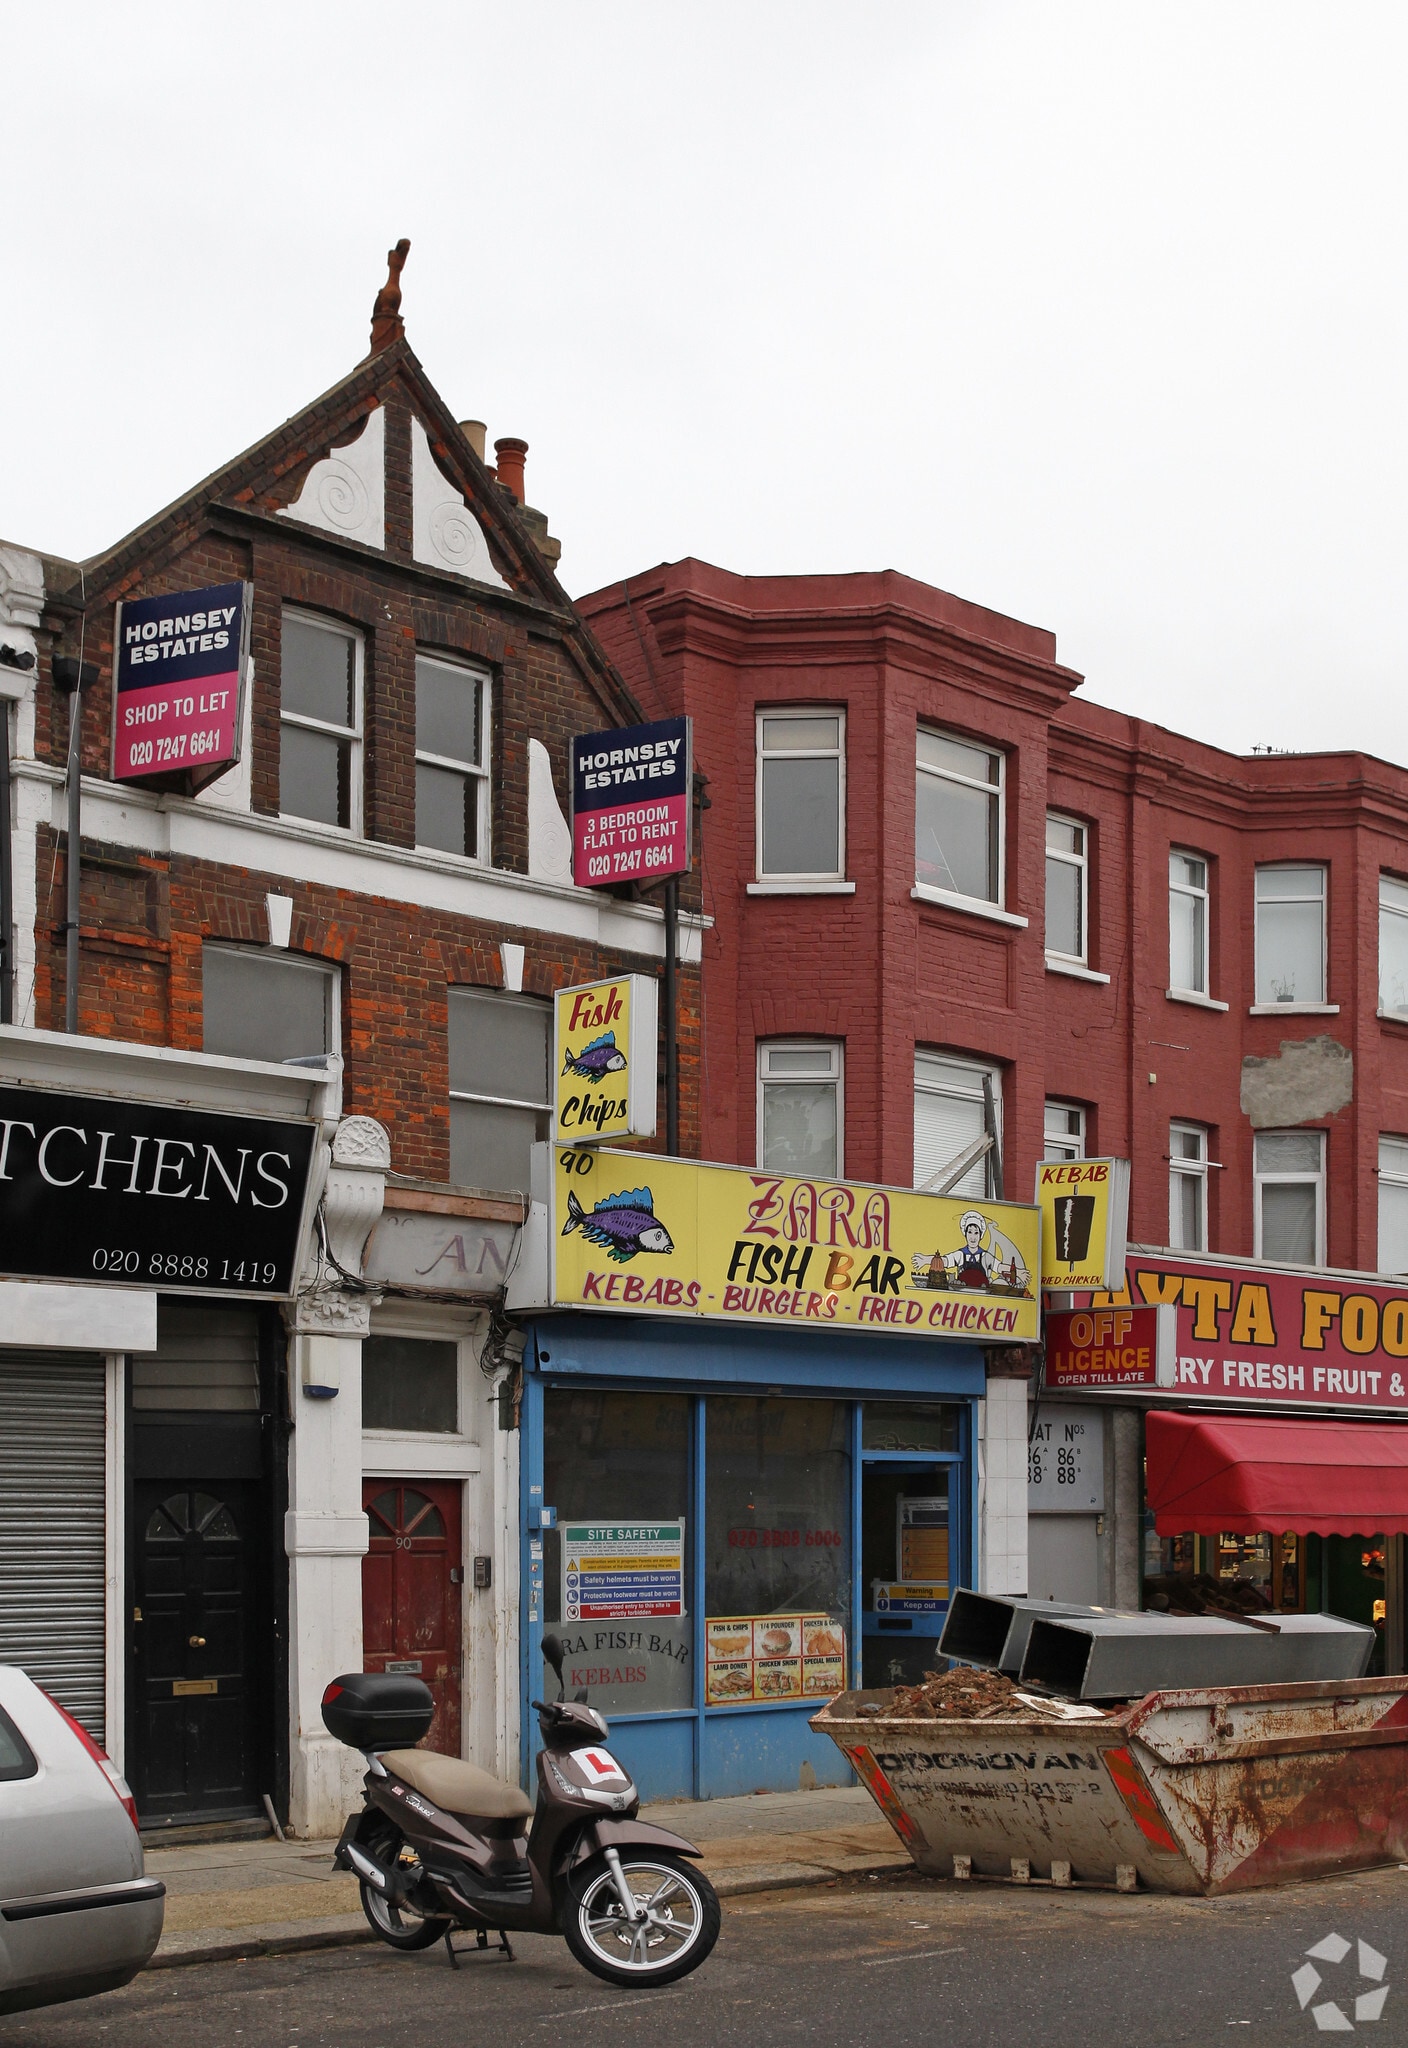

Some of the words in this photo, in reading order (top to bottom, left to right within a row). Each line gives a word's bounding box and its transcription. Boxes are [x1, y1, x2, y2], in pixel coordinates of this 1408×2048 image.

[126, 606, 237, 644] HORNSEY
[130, 630, 230, 665] ESTATES
[124, 701, 169, 727] SHOP
[173, 697, 194, 718] TO
[200, 690, 229, 713] LET
[129, 740, 153, 766] 020
[157, 734, 187, 762] 7247
[190, 728, 221, 756] 6641
[579, 738, 682, 772] HORNSEY
[584, 759, 676, 790] ESTATES
[587, 818, 596, 833] 3
[600, 805, 669, 831] BEDROOM
[583, 832, 616, 850] FLAT
[619, 828, 637, 844] TO
[642, 821, 678, 838] RENT
[589, 854, 610, 877] 020
[613, 849, 642, 873] 7247
[645, 844, 673, 868] 6641
[568, 986, 623, 1032] Fish
[560, 1093, 628, 1132] Chips
[0, 1119, 291, 1208] TCHENS
[559, 1150, 594, 1176] 90
[1041, 1165, 1109, 1185] KEBAB
[743, 1175, 892, 1252] ZARA
[92, 1248, 140, 1273] 020
[149, 1253, 209, 1279] 8888
[219, 1259, 276, 1284] 1419
[727, 1240, 813, 1289] FISH
[824, 1250, 905, 1296] BAR
[1041, 1275, 1061, 1285] RIED
[1063, 1275, 1102, 1285] CHICKEN
[582, 1271, 702, 1308] KEBABS
[722, 1284, 839, 1319] BURGERS
[858, 1296, 923, 1325] FRIED
[928, 1302, 1019, 1333] CHICKEN
[1069, 1310, 1133, 1348] OFF
[1055, 1347, 1150, 1372] LICENCE
[1057, 1374, 1087, 1385] OPEN
[1090, 1373, 1114, 1384] TILL
[1117, 1372, 1145, 1383] LATE
[1175, 1357, 1214, 1385] RY
[1222, 1360, 1305, 1392] FRESH
[1313, 1367, 1382, 1396] FRUIT
[1389, 1372, 1405, 1397] &
[395, 1536, 412, 1550] 90
[588, 1529, 614, 1540] SITE
[617, 1529, 660, 1540] SAFETY
[728, 1528, 758, 1547] 020
[805, 1529, 841, 1547] 6006
[584, 1576, 605, 1584] Safety
[606, 1575, 632, 1583] helmets
[905, 1586, 934, 1596] Warning
[903, 1601, 923, 1610] Keep
[770, 1621, 795, 1629] POUNDER
[803, 1620, 823, 1628] CHICKEN
[594, 1631, 643, 1650] FISH
[647, 1634, 689, 1664] BAR
[804, 1657, 825, 1665] SPECIAL
[826, 1656, 842, 1664] MIXED
[570, 1666, 647, 1686] KEBABS
[782, 1659, 798, 1667] SHISH
[585, 1753, 617, 1774] L
